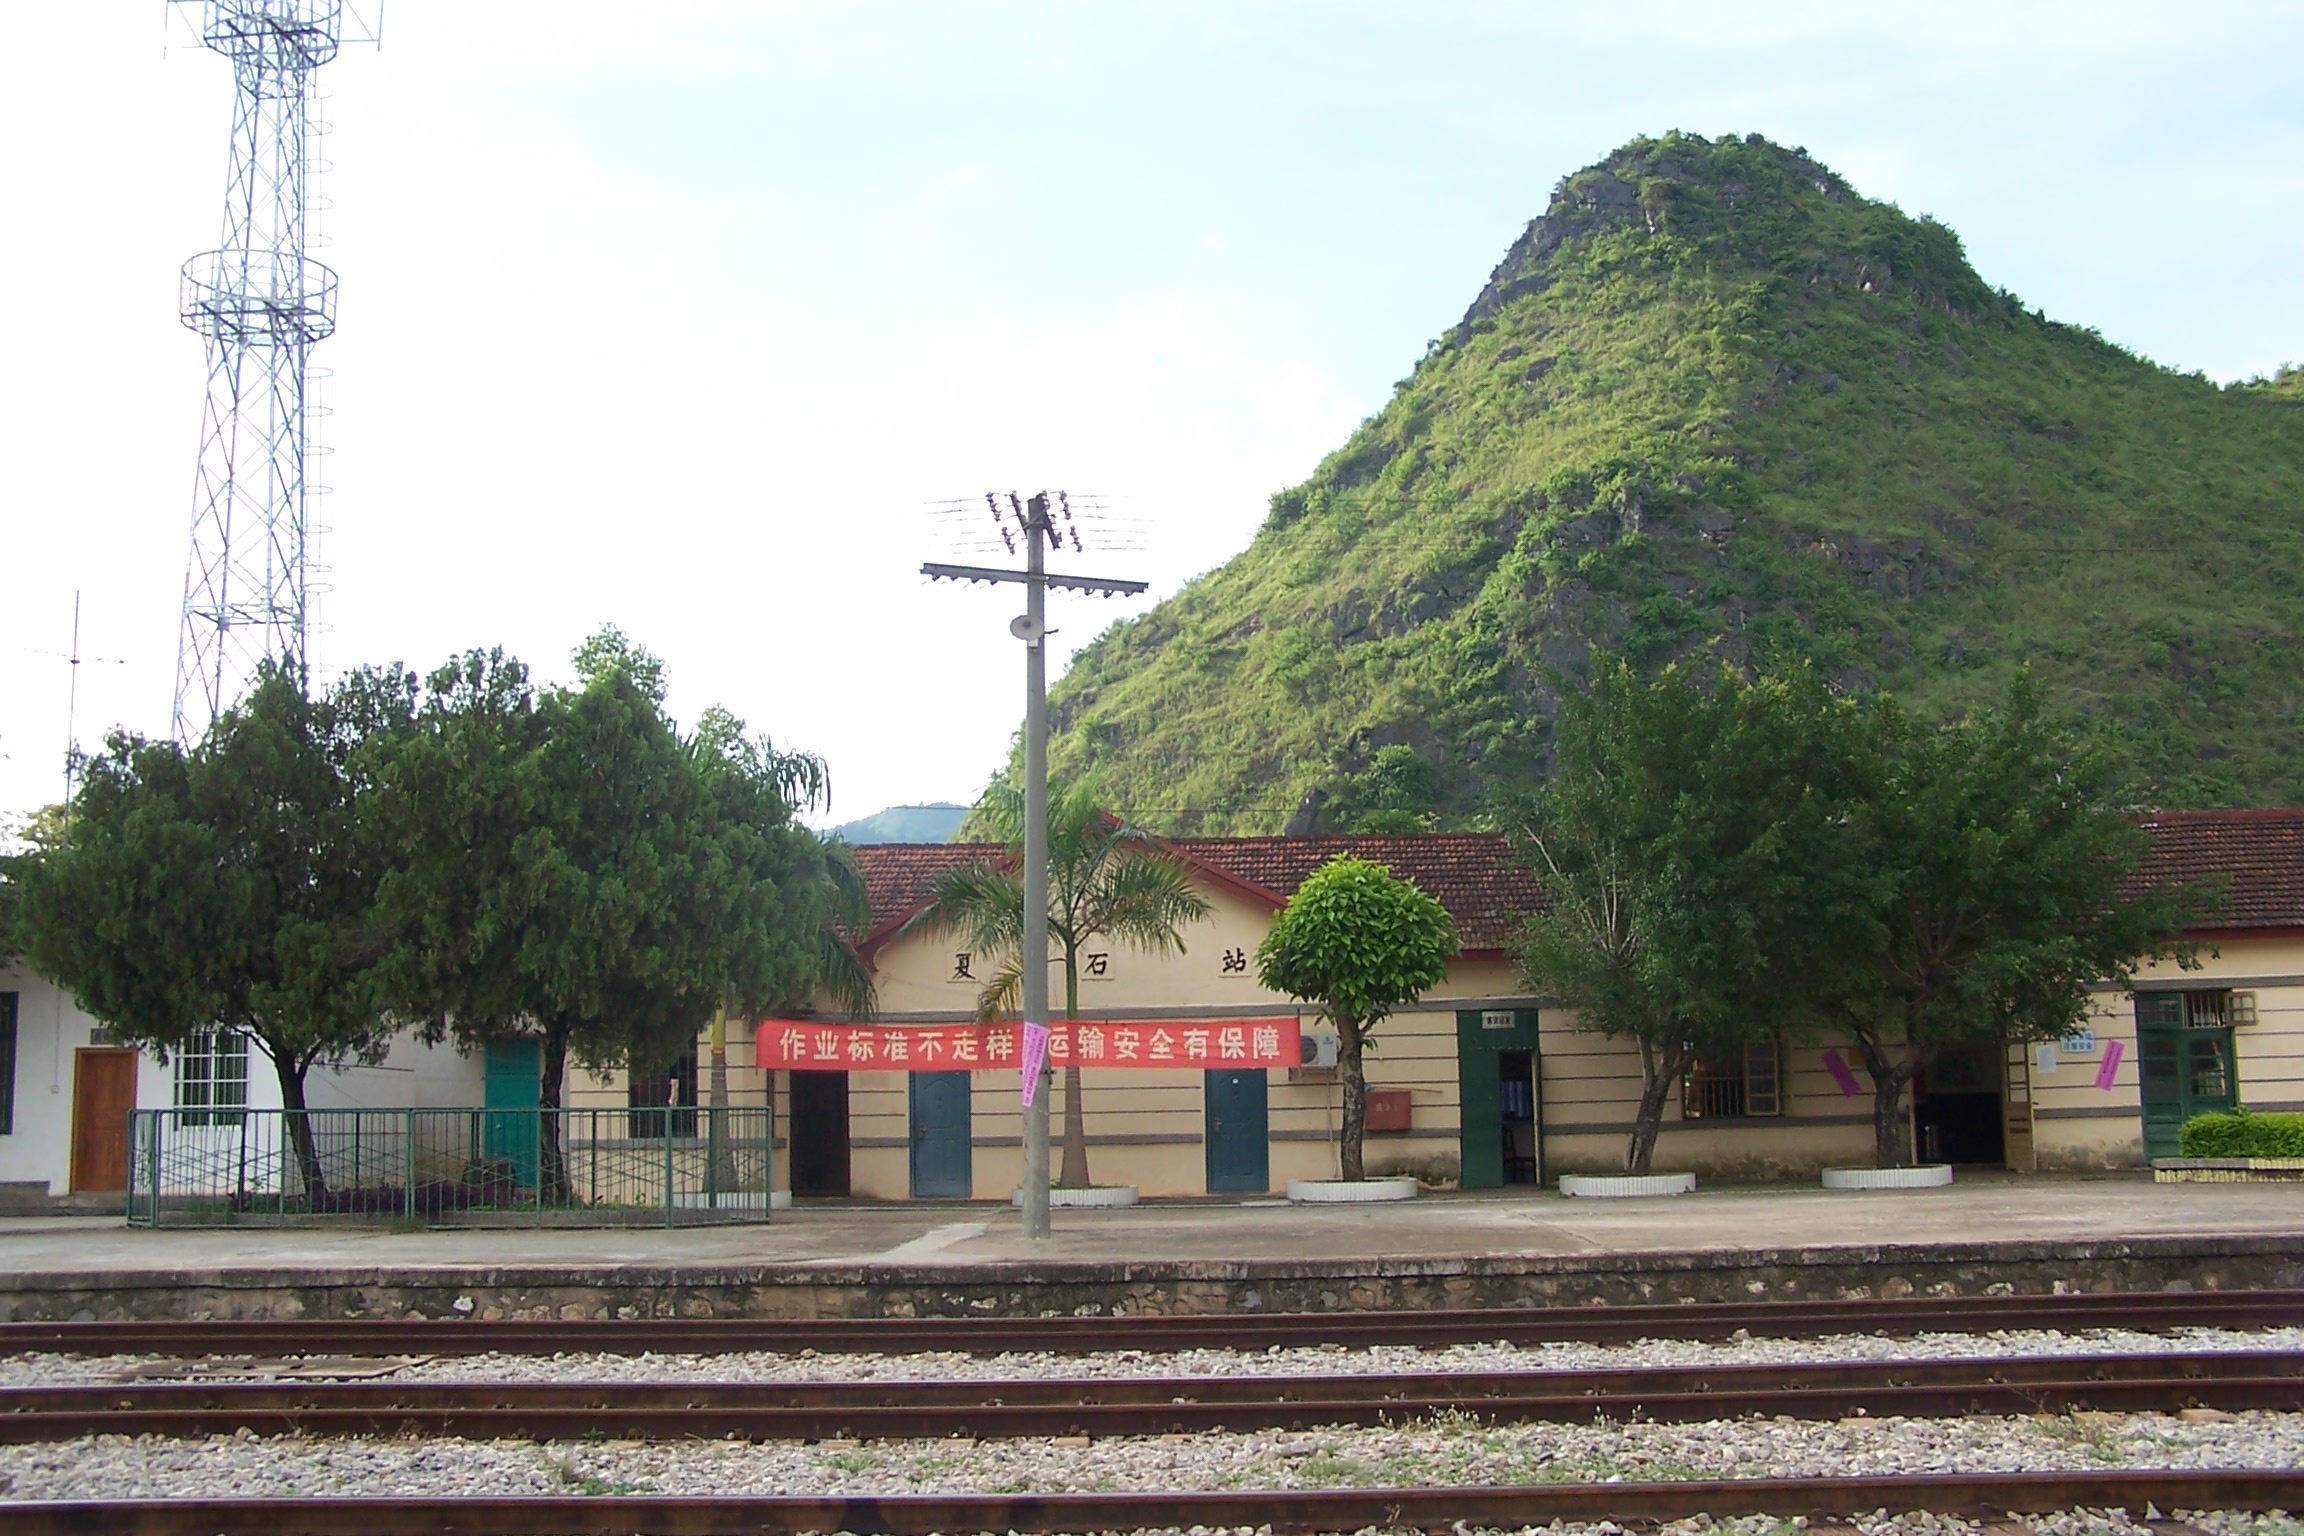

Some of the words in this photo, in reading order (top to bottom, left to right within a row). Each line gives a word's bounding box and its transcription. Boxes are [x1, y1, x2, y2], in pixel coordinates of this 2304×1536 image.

[952, 947, 1247, 980] 夏石站
[780, 1028, 1013, 1062] 作业标准不走样
[1048, 1024, 1280, 1060] 运输安全有保障
